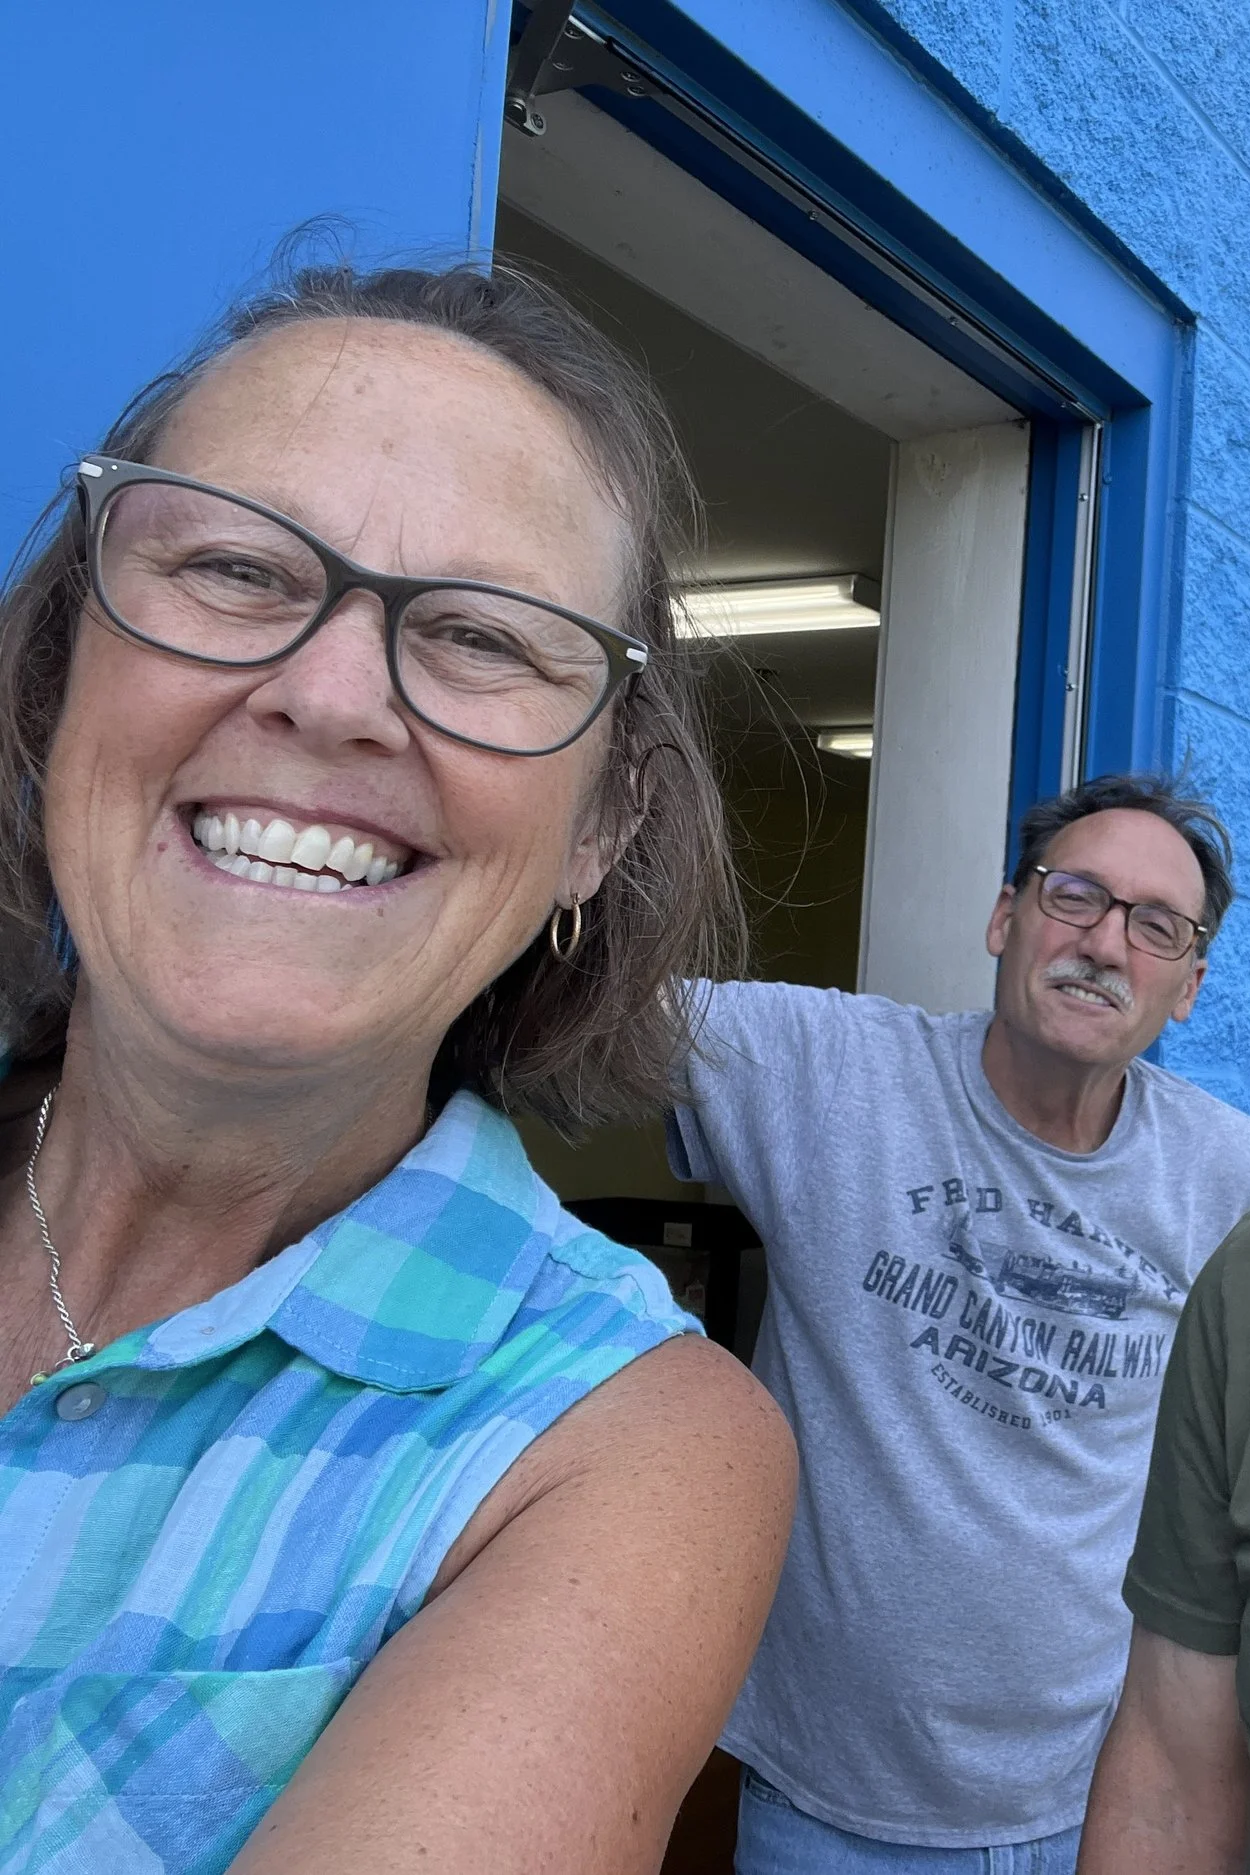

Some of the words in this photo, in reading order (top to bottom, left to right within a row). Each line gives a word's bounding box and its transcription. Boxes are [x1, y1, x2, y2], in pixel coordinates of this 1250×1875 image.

[906, 1178, 1003, 1215] FRD
[862, 1250, 959, 1320] GRAND
[959, 1290, 1058, 1365] CANYON
[1060, 1328, 1167, 1379] RAILWAY
[910, 1326, 1106, 1410] ARIZONA
[931, 1363, 1032, 1430] ESTABLISHED
